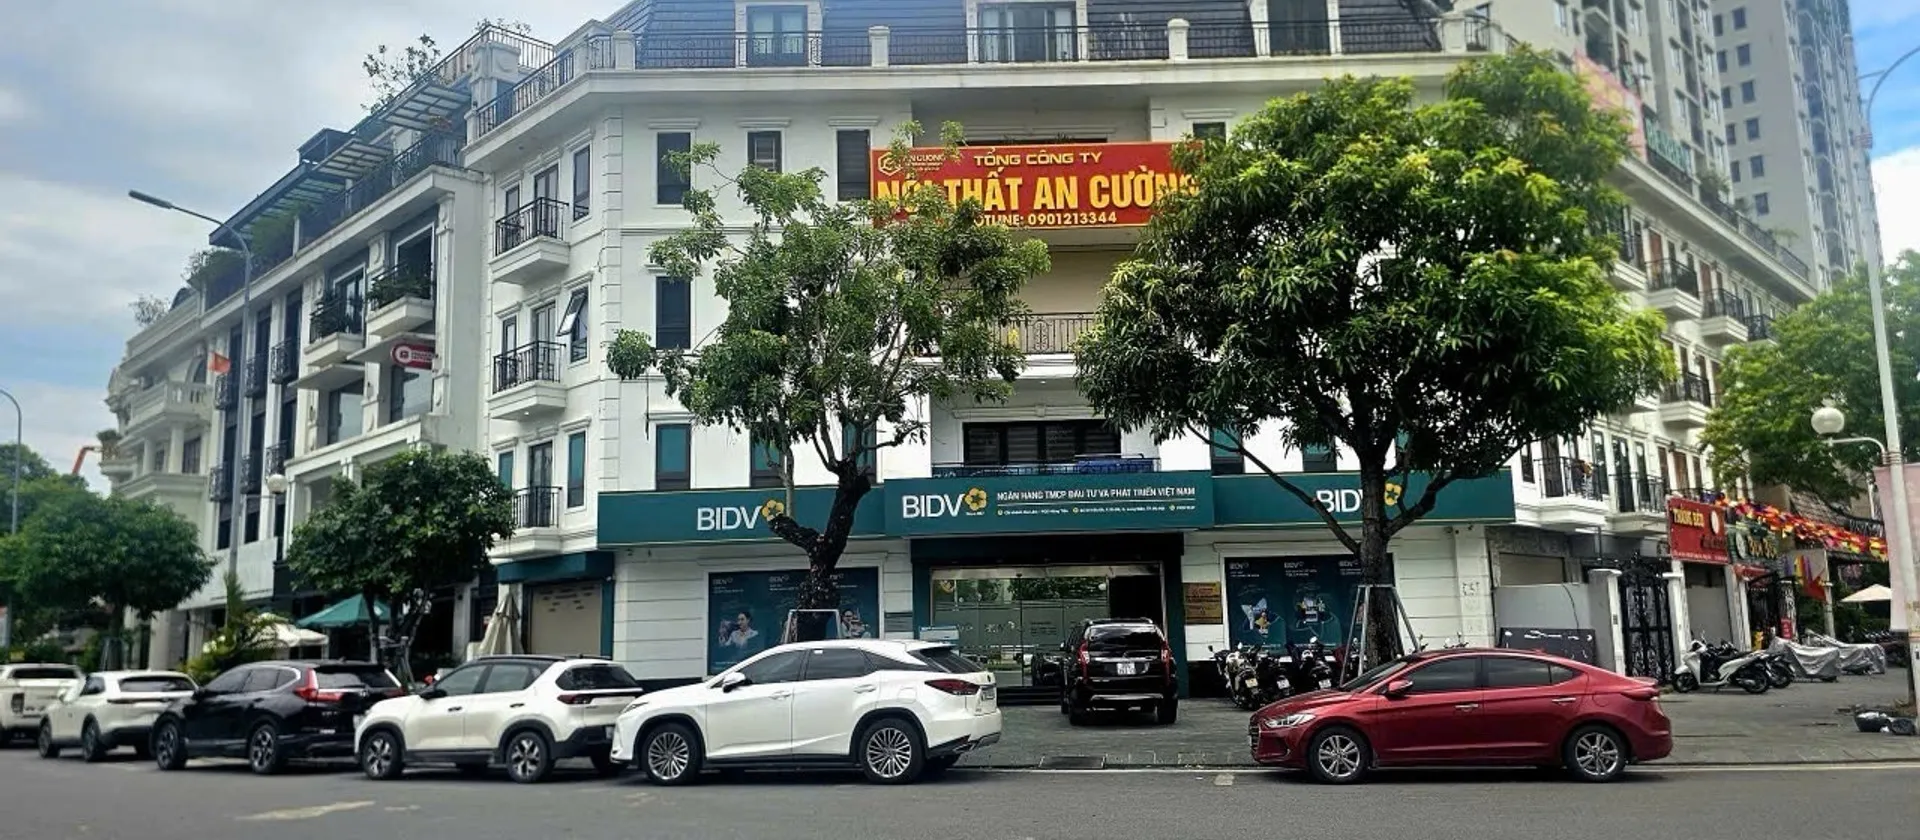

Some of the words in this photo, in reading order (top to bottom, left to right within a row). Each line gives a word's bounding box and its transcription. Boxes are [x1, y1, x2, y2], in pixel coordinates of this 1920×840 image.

[974, 147, 1021, 166] TỔNG
[1026, 149, 1074, 165] CÔNG
[1079, 152, 1102, 163] TY
[943, 166, 1022, 212] THẤT
[1033, 176, 1078, 210] AN
[971, 214, 1024, 227] OTLINE:
[1028, 211, 1117, 225] 0901213344
[902, 493, 965, 519] BIDV
[1316, 488, 1364, 513] BID
[697, 506, 763, 531] BIDV
